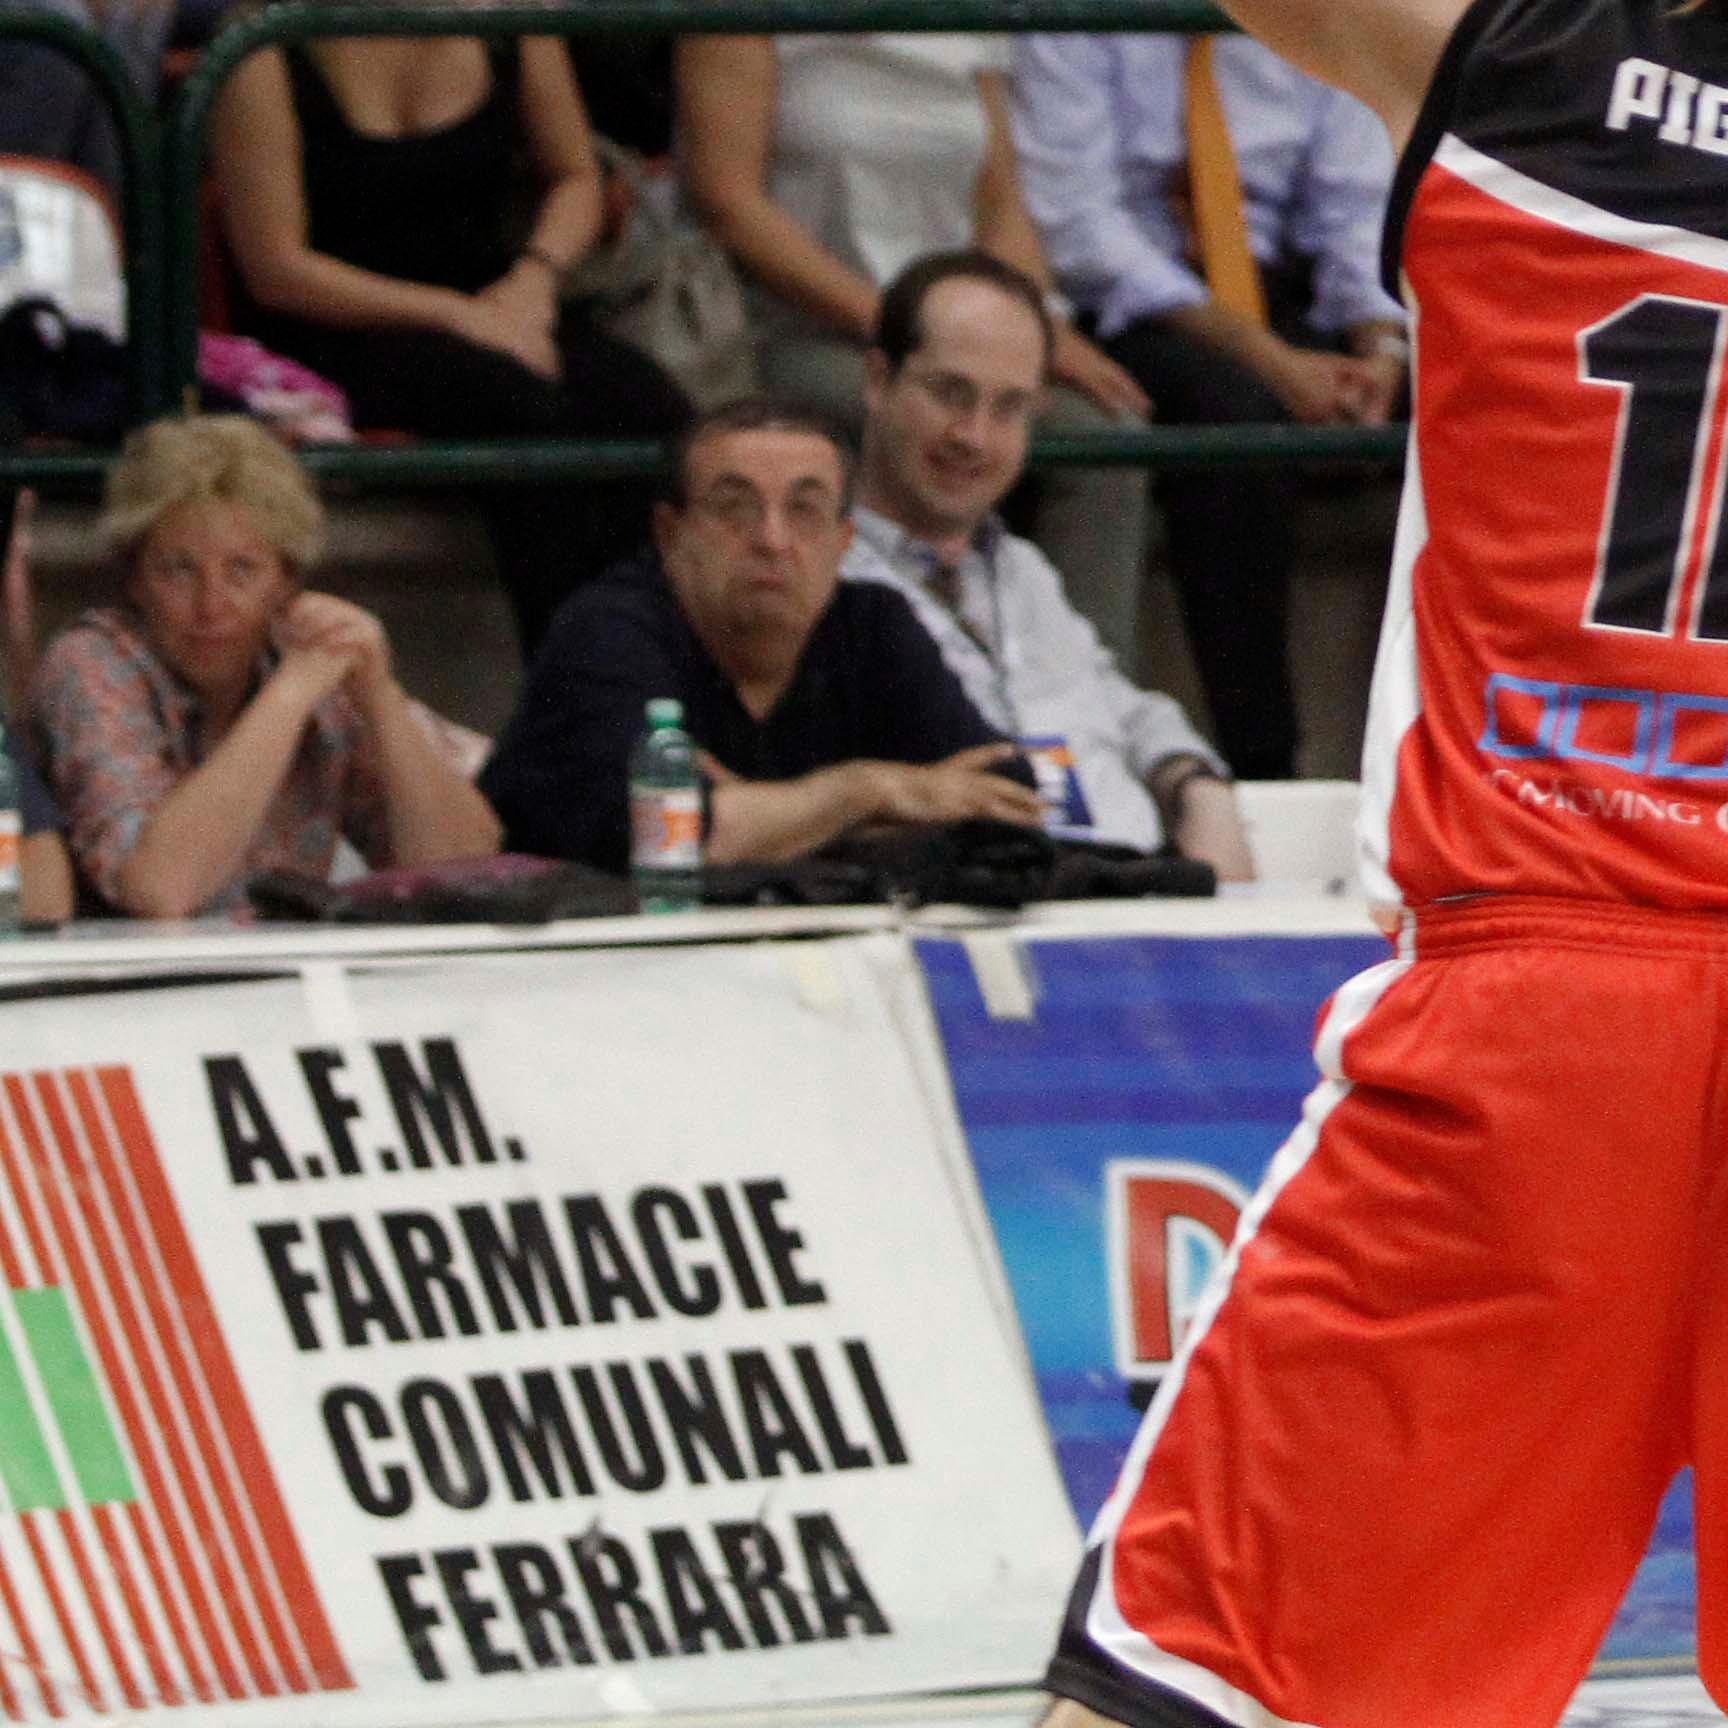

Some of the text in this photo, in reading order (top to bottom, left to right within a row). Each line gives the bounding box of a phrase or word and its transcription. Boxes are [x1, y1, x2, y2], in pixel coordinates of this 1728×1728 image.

[202, 1035, 527, 1188] A.F.M.
[251, 1176, 830, 1353] FARMACIE
[1107, 1160, 1252, 1378] D
[319, 1336, 913, 1520] COMUNALI
[375, 1509, 893, 1684] FERRARA
